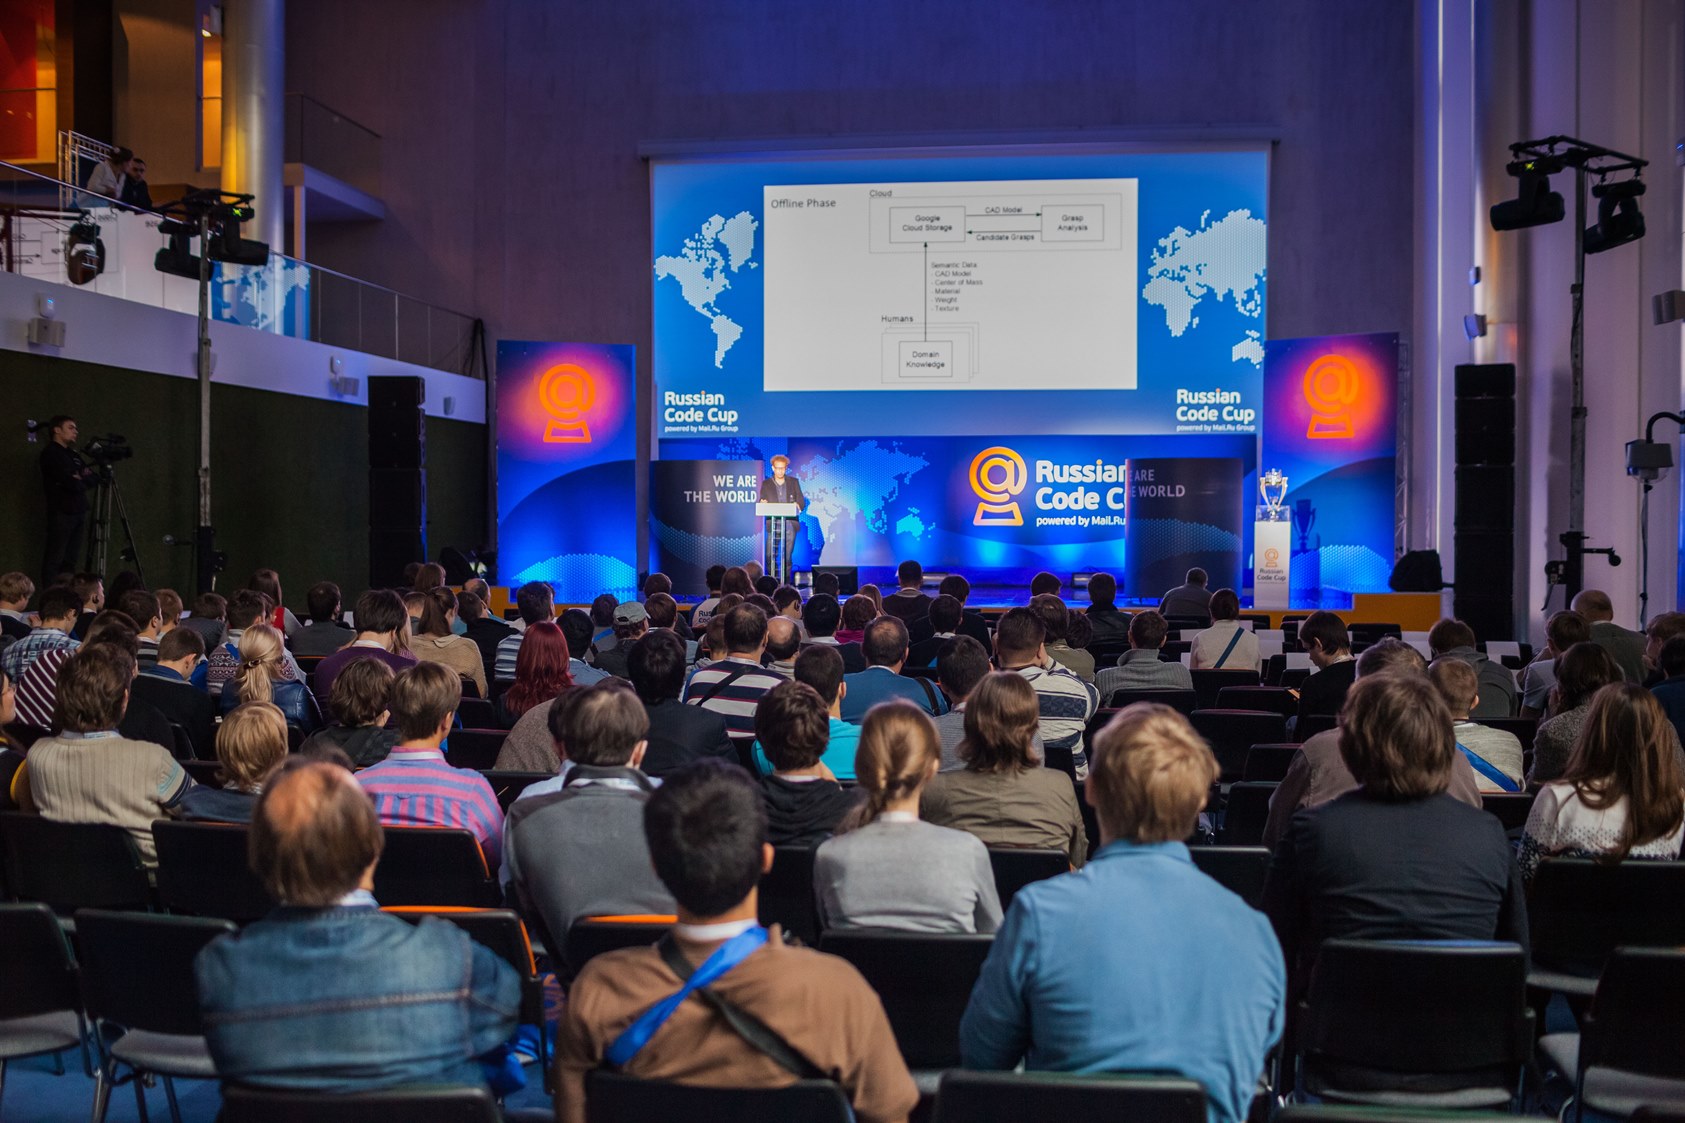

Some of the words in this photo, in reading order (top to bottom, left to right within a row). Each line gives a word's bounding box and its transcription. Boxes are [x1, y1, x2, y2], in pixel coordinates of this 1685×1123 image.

[869, 189, 892, 198] Cloud
[771, 199, 804, 208] Offline
[807, 198, 836, 208] Phase
[985, 206, 1000, 214] CAD
[915, 214, 940, 223] Google
[1061, 214, 1084, 222] Grasp
[902, 224, 923, 232] Cloud
[925, 224, 952, 232] Storage
[1057, 224, 1088, 233] Analysis
[976, 233, 1009, 241] Candidate
[1010, 233, 1035, 242] Grasps
[931, 261, 960, 269] Semantic
[881, 315, 914, 323] Humans
[906, 360, 945, 369] Knowledge
[664, 390, 725, 406] Russian
[1176, 388, 1241, 404] Russian
[664, 407, 704, 422] Code
[707, 407, 739, 426] Cup
[1176, 405, 1219, 421] Code
[1222, 406, 1255, 425] Cup
[664, 425, 690, 433] powered
[690, 425, 698, 433] by
[720, 425, 739, 433] Group
[1176, 424, 1203, 433] powered
[1203, 424, 1212, 433] by
[1236, 424, 1256, 432] Group
[1134, 469, 1155, 481] ARE
[713, 475, 734, 487] WE
[736, 475, 757, 487] ARE
[1138, 485, 1186, 497] WORLD
[684, 490, 711, 503] THE
[715, 490, 757, 503] WORLD
[1035, 486, 1100, 510] Code
[1036, 516, 1076, 527] powered
[1077, 515, 1090, 528] by
